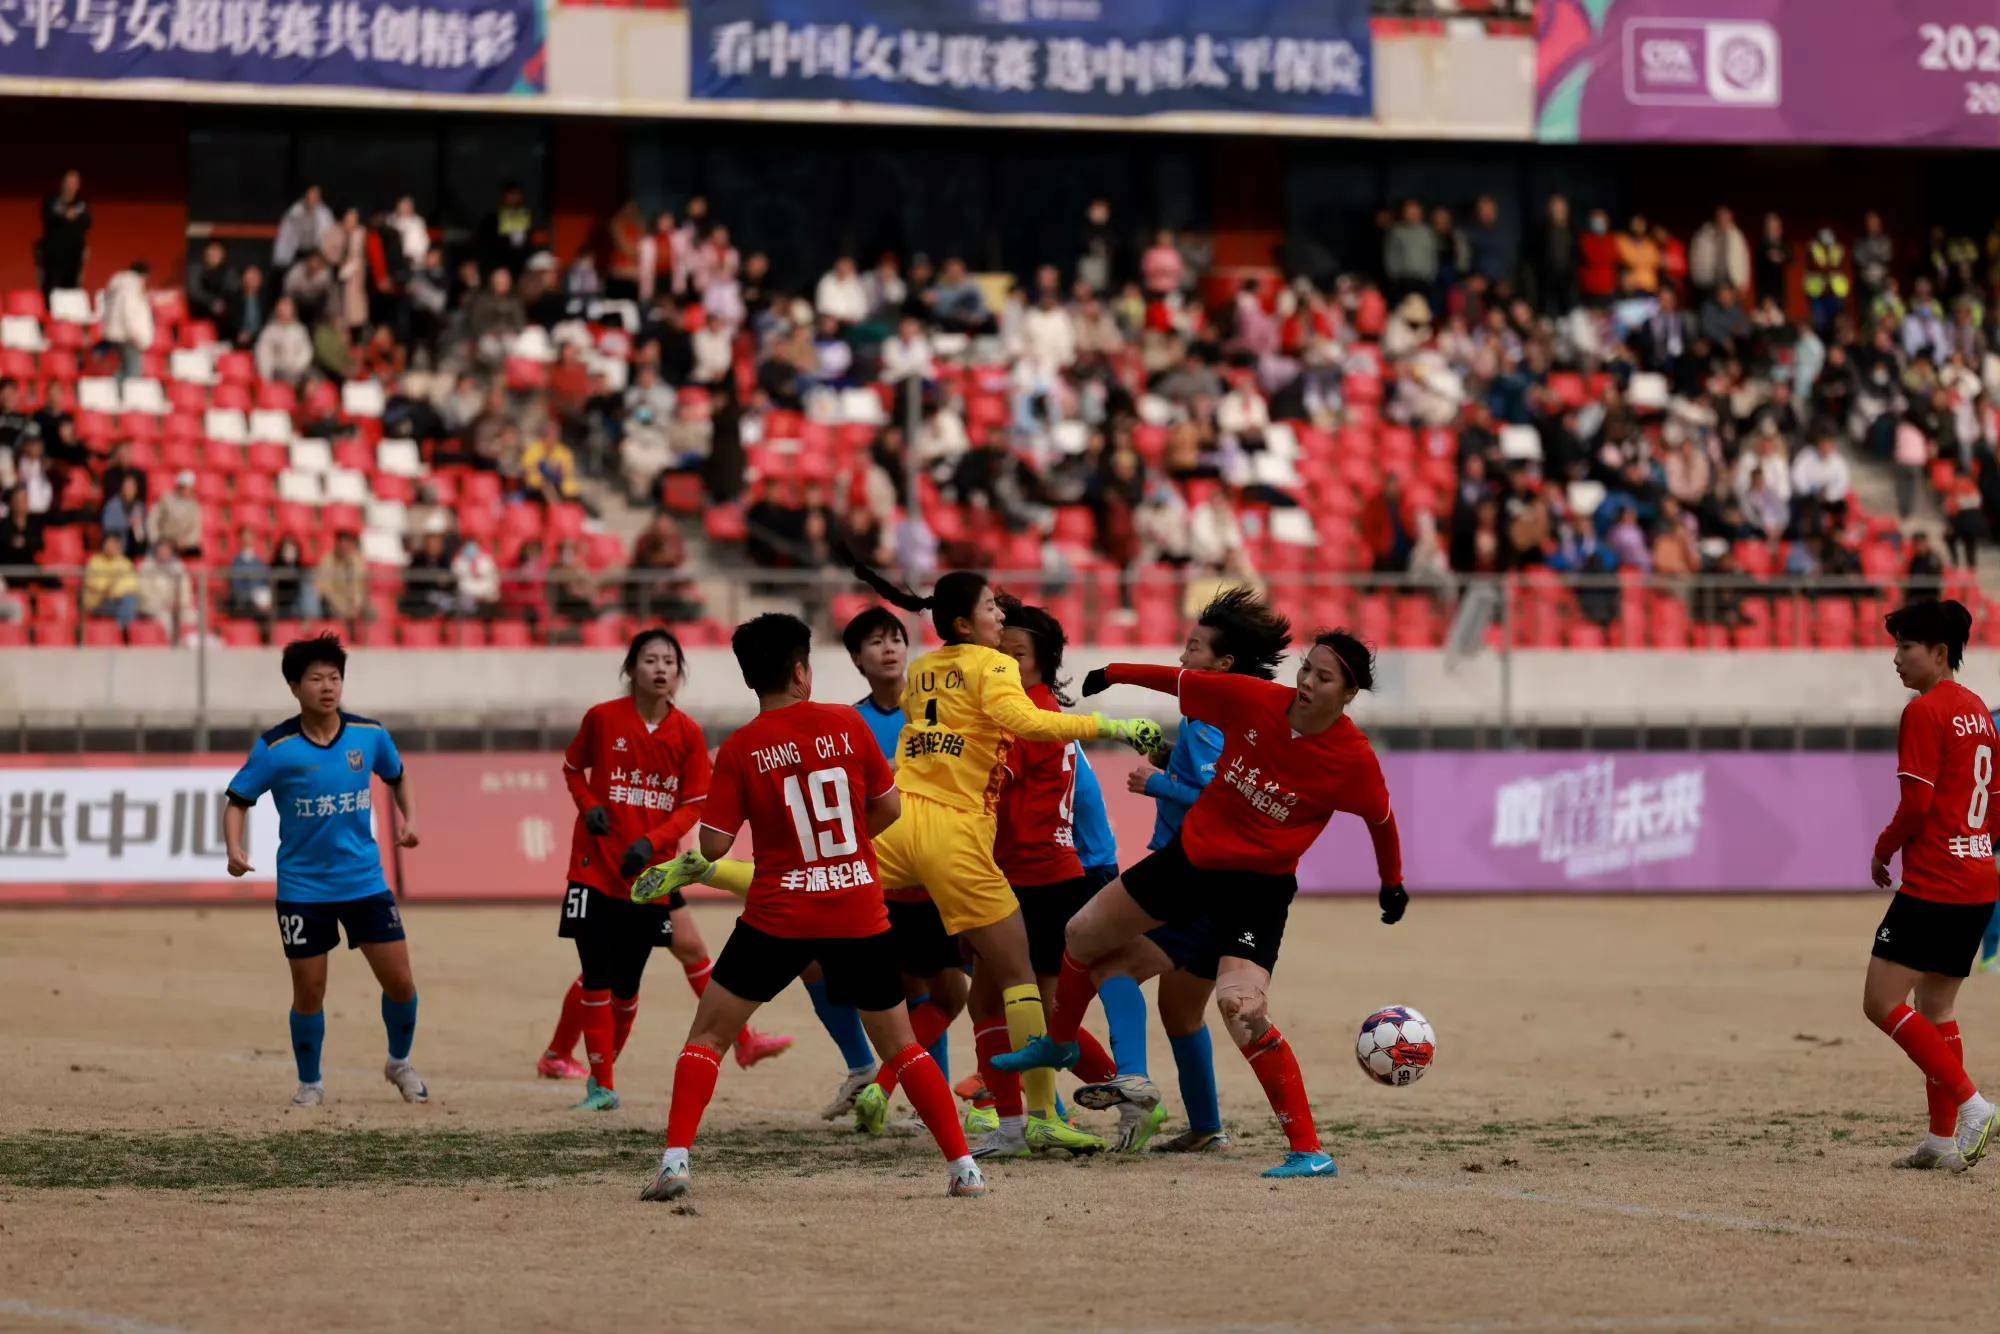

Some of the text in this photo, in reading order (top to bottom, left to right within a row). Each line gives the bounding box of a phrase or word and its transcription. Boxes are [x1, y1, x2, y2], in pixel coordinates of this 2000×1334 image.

[751, 741, 801, 774] ZHANG
[608, 784, 675, 813] 丰源轮胎
[1967, 744, 1992, 829] 8
[295, 788, 371, 818] 江苏无锡
[783, 766, 858, 863] 19
[780, 859, 874, 892] 丰源轮胎
[566, 888, 588, 918] 51
[280, 914, 307, 946] 32
